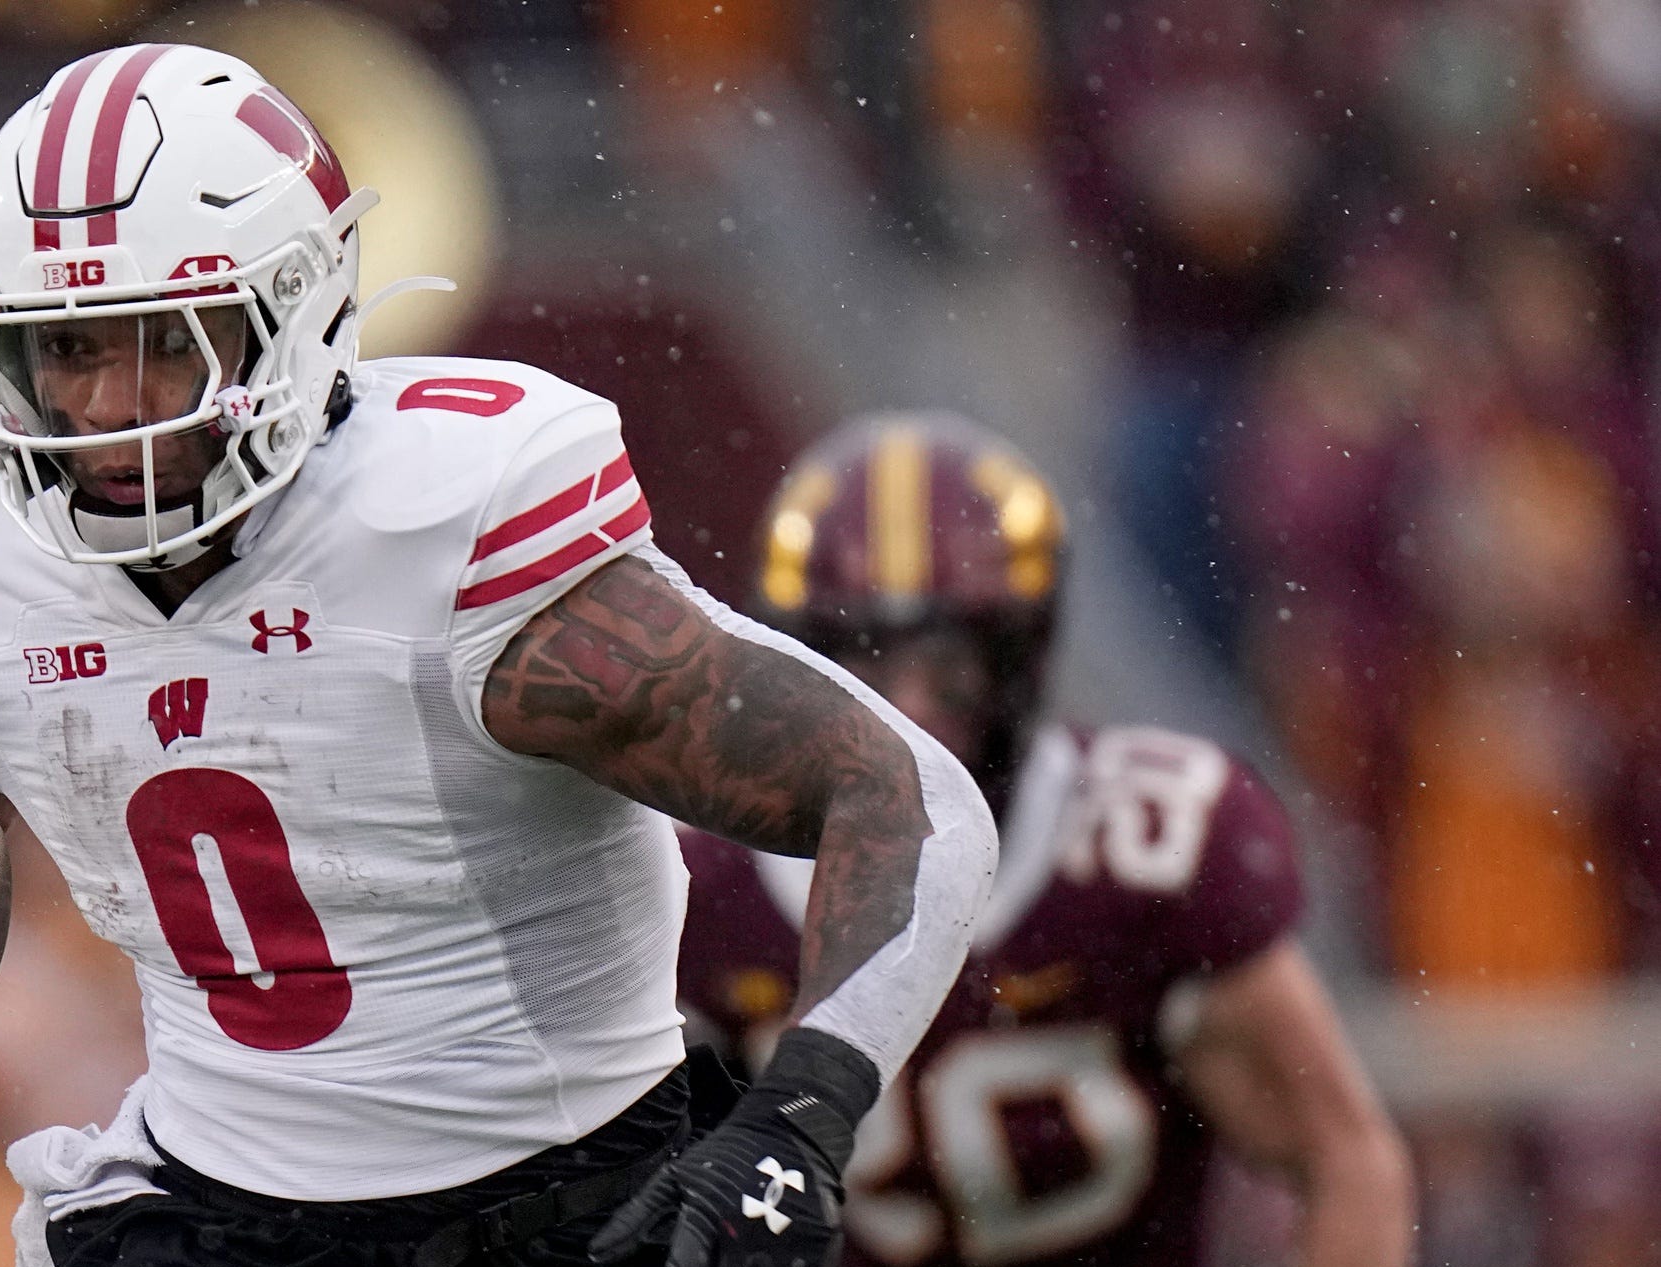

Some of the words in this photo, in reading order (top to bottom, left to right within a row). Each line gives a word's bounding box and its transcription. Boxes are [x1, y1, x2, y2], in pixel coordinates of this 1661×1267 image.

[396, 378, 525, 417] 0
[148, 677, 208, 752] W
[126, 768, 352, 1051] 0
